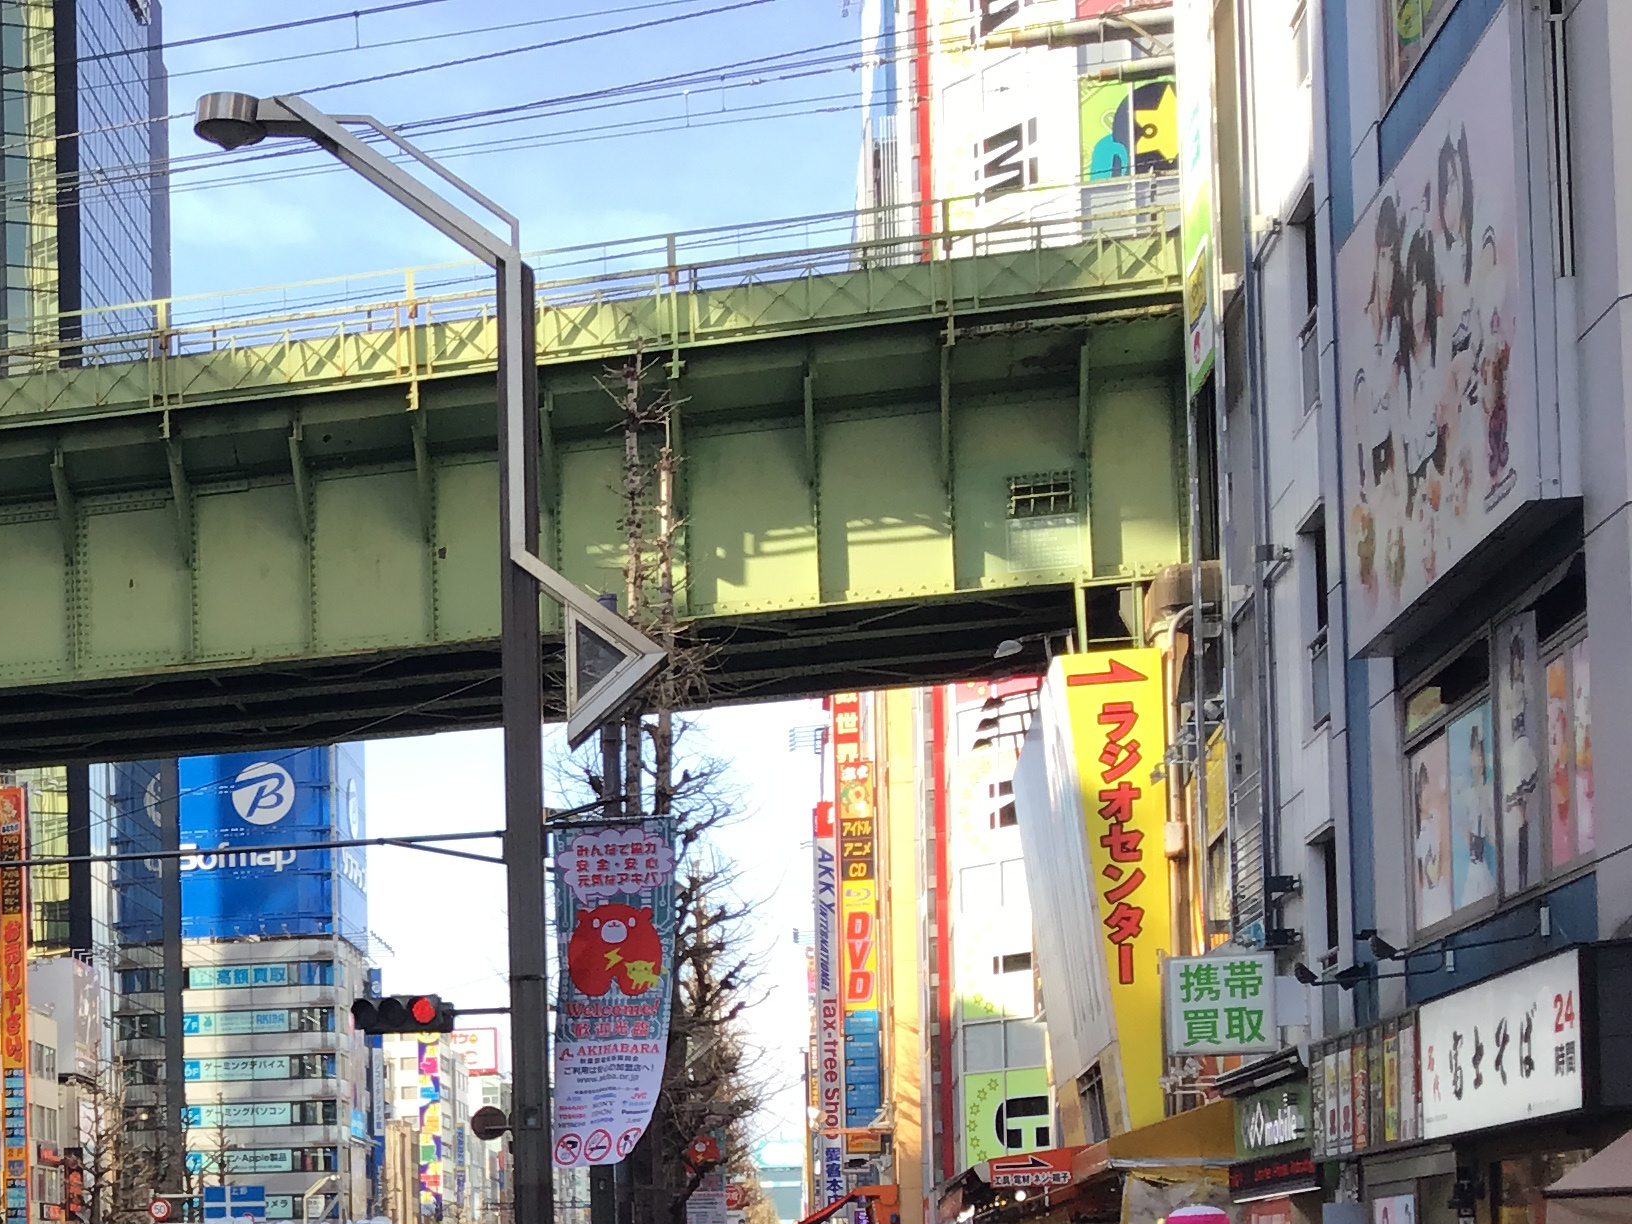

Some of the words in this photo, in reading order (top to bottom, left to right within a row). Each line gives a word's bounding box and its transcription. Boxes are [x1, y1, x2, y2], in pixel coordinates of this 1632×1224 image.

[842, 820, 872, 838] アイドル
[576, 842, 657, 858] みんなで協力
[843, 841, 872, 858] アニメ
[1097, 701, 1147, 985] ラジオセンター
[576, 857, 659, 873] 安全・安心
[848, 863, 868, 879] CD
[577, 872, 659, 888] 元気なアキバ
[817, 845, 836, 914] AKKY
[847, 911, 873, 1003] DVD
[217, 966, 286, 985] 高額買取
[1179, 960, 1264, 1003] 携帯
[566, 999, 660, 1018] Welcome!
[1554, 990, 1575, 1033] 24
[1183, 1006, 1266, 1047] 買取
[577, 1043, 660, 1056] AKIHABARA
[823, 998, 840, 1083] Tax-free
[203, 1059, 285, 1072] ゲーミングデバイス
[1554, 1041, 1576, 1077] 時間
[205, 1106, 286, 1119] ゲーミングパソコン
[153, 1204, 166, 1215] 50
